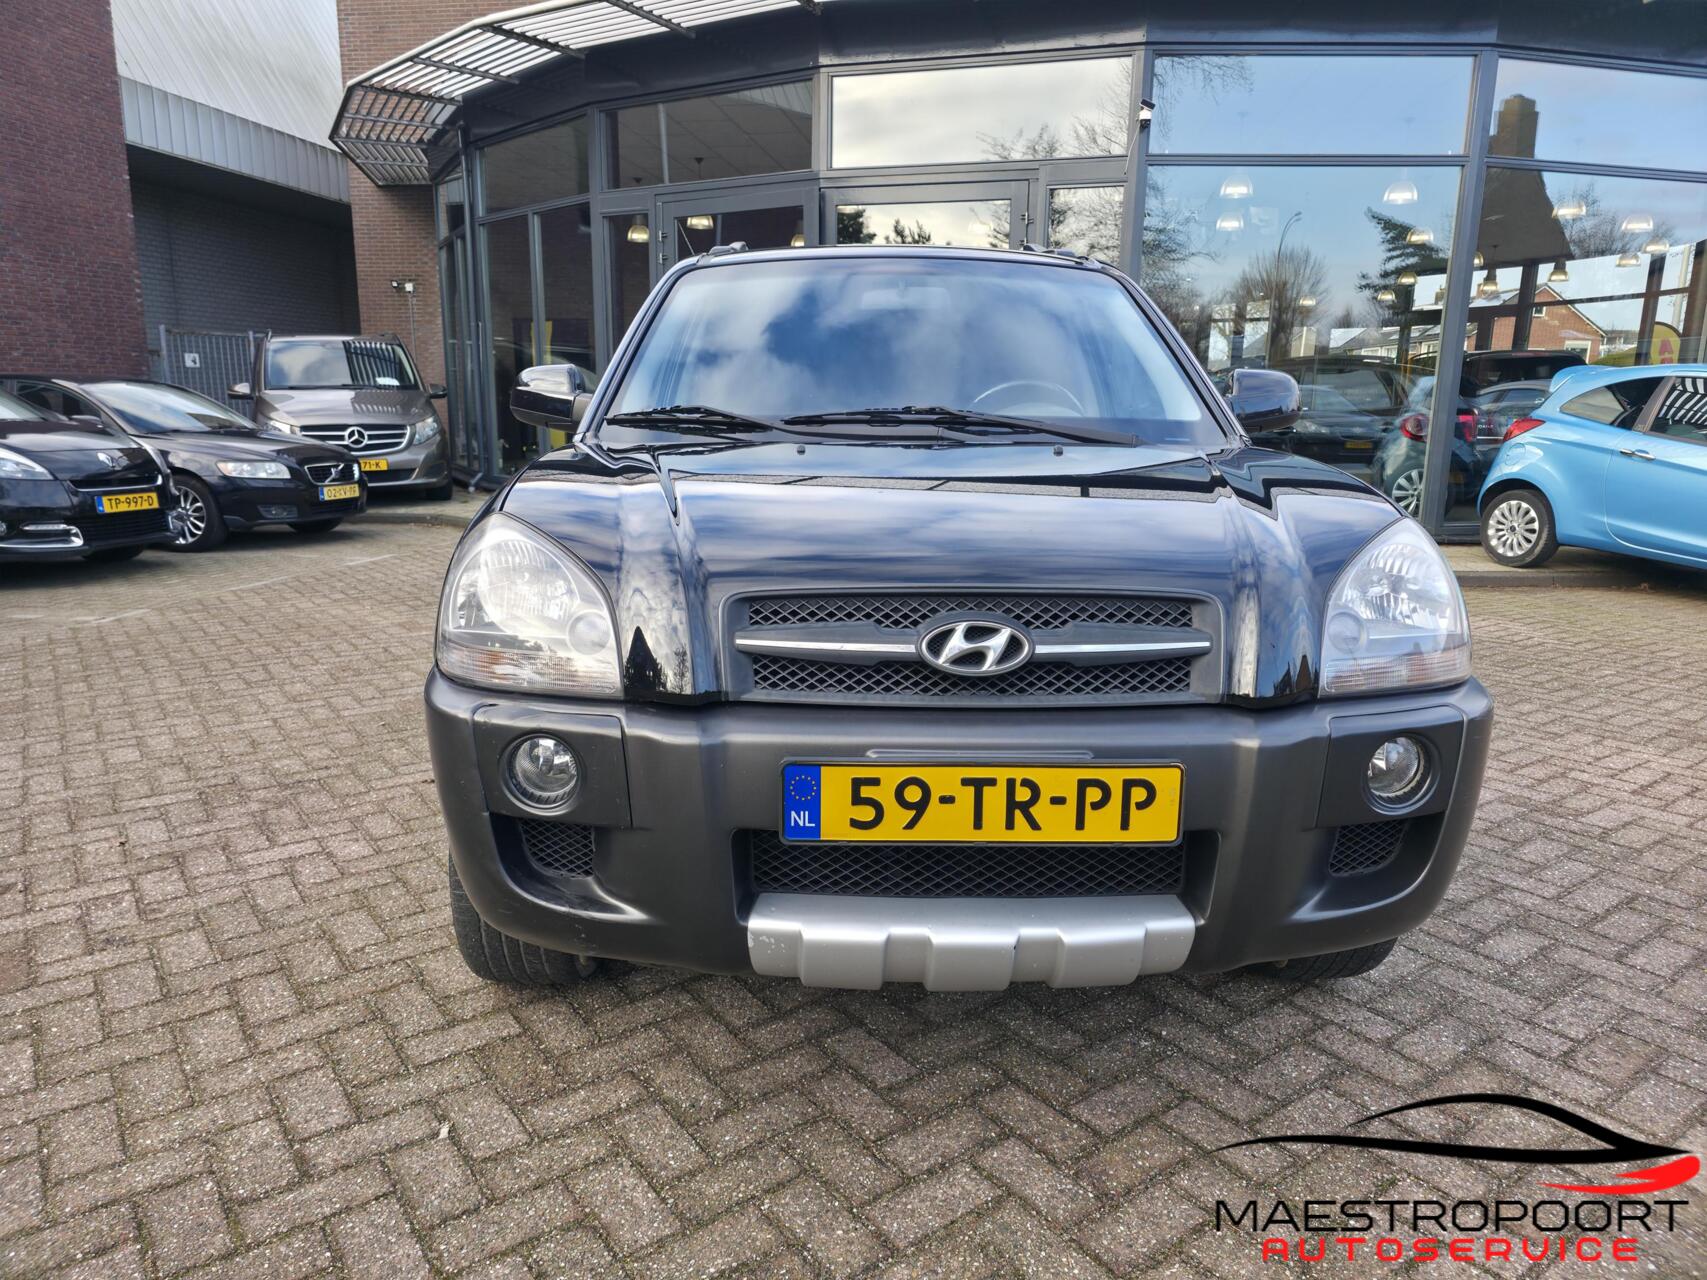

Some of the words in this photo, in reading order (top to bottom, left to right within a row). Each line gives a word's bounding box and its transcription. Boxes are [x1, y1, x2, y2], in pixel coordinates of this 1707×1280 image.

[106, 495, 154, 510] TP-997-D
[848, 776, 1157, 831] 59-TR-PP
[790, 810, 816, 827] NL
